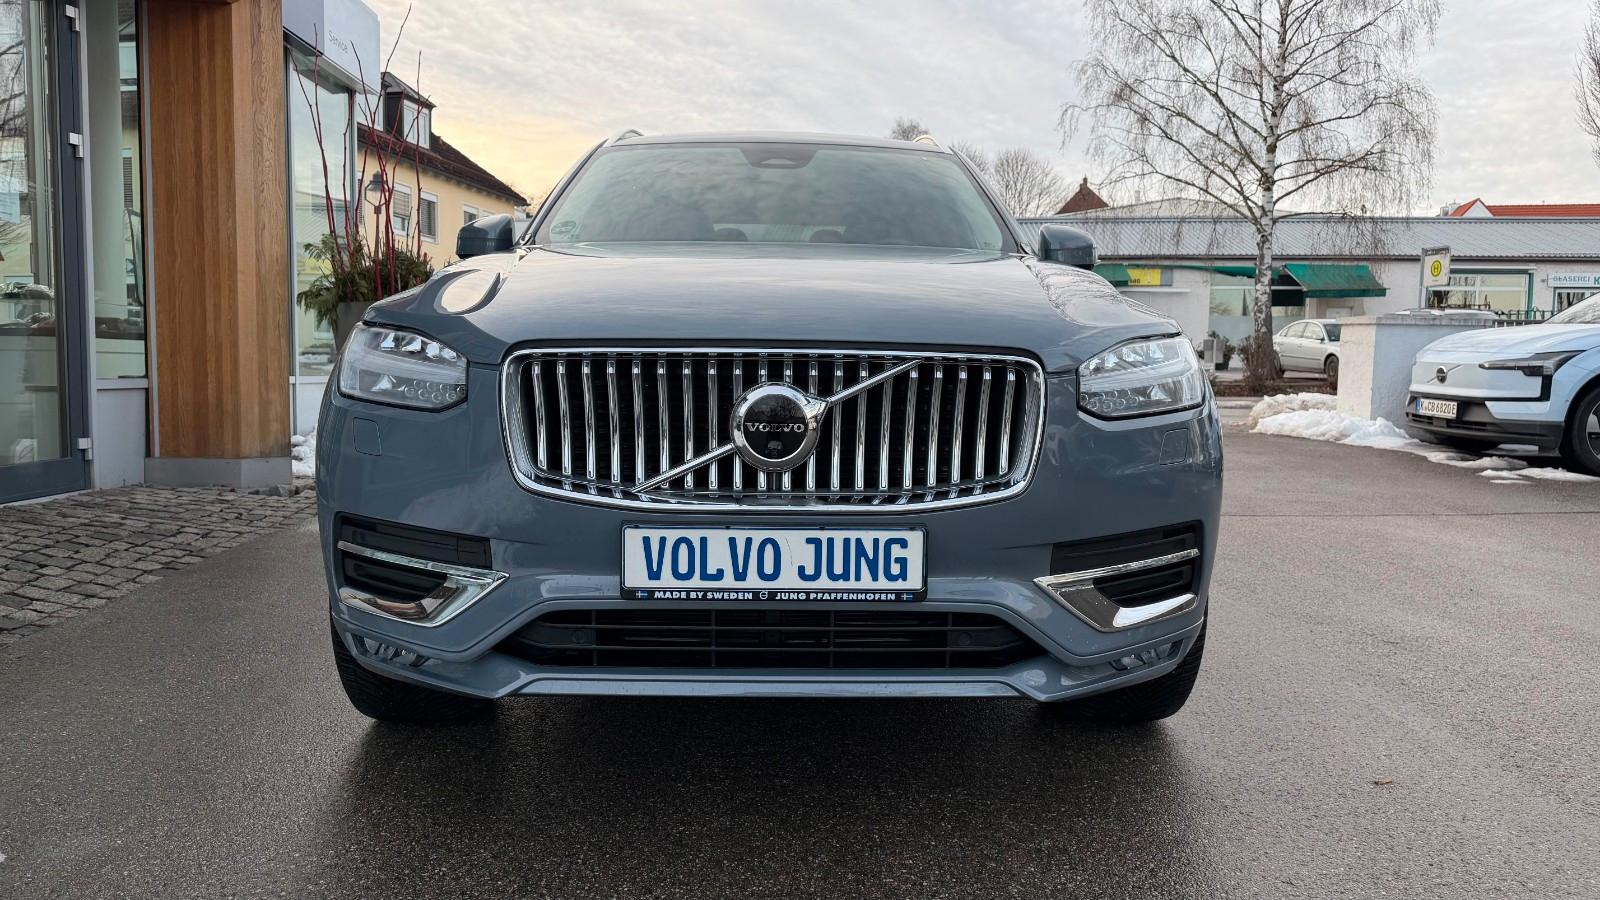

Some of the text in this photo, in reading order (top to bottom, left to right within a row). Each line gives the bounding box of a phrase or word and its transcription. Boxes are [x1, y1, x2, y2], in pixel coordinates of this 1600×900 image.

[328, 29, 348, 53] Service
[1552, 275, 1591, 283] GLASEREI
[745, 422, 805, 433] VOLVO
[642, 535, 909, 582] VOLVO JUNG
[653, 591, 687, 599] MADE
[706, 591, 753, 600] SWEDEN
[775, 592, 807, 600] JUNG
[809, 592, 896, 600] PFAFFENHOFEN
